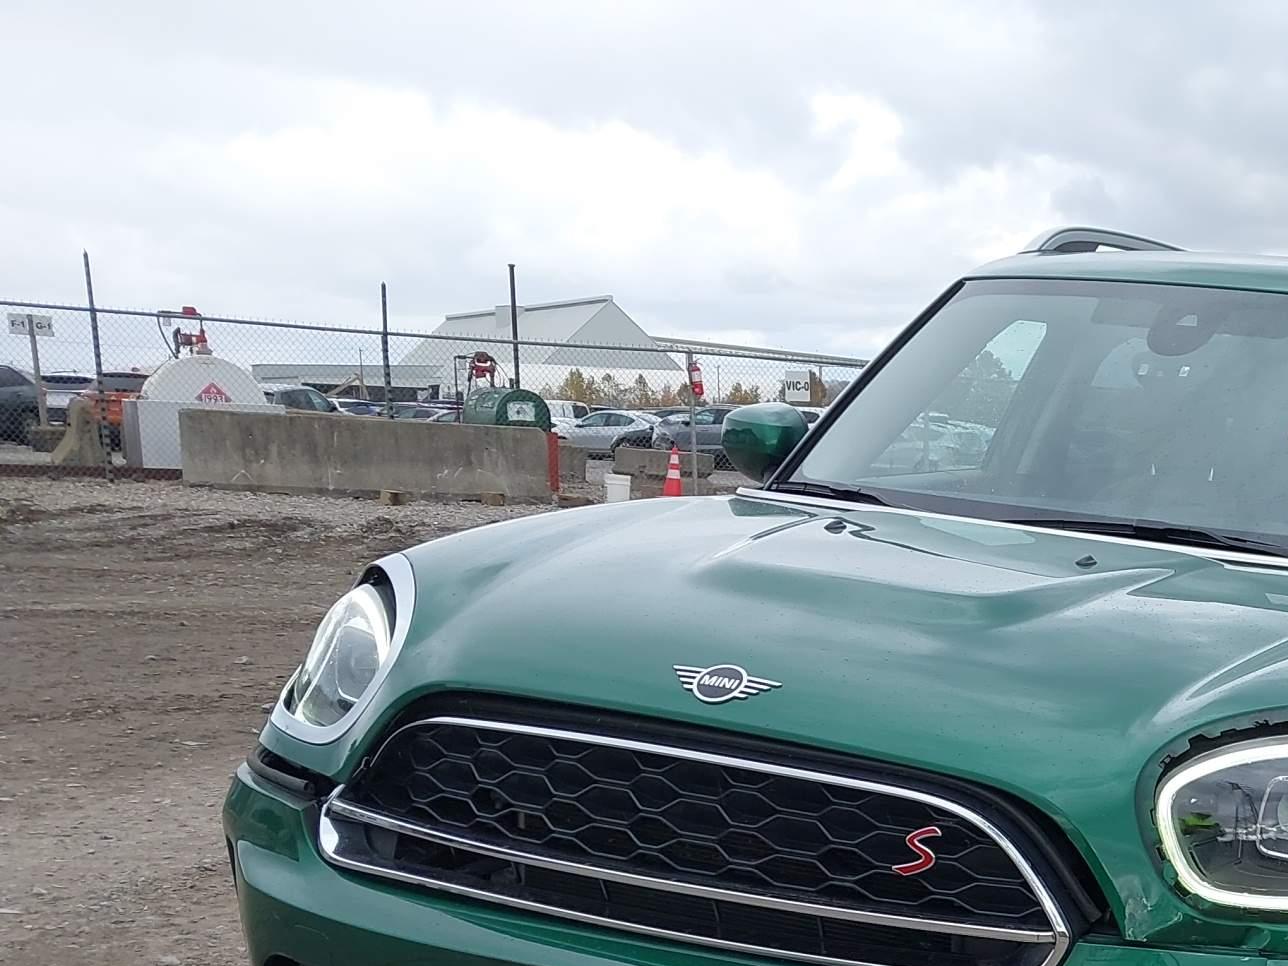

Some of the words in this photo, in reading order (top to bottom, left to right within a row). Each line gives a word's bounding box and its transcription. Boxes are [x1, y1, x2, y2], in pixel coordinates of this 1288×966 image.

[10, 320, 25, 328] F-1
[699, 674, 741, 690] MINI
[891, 826, 942, 876] S
